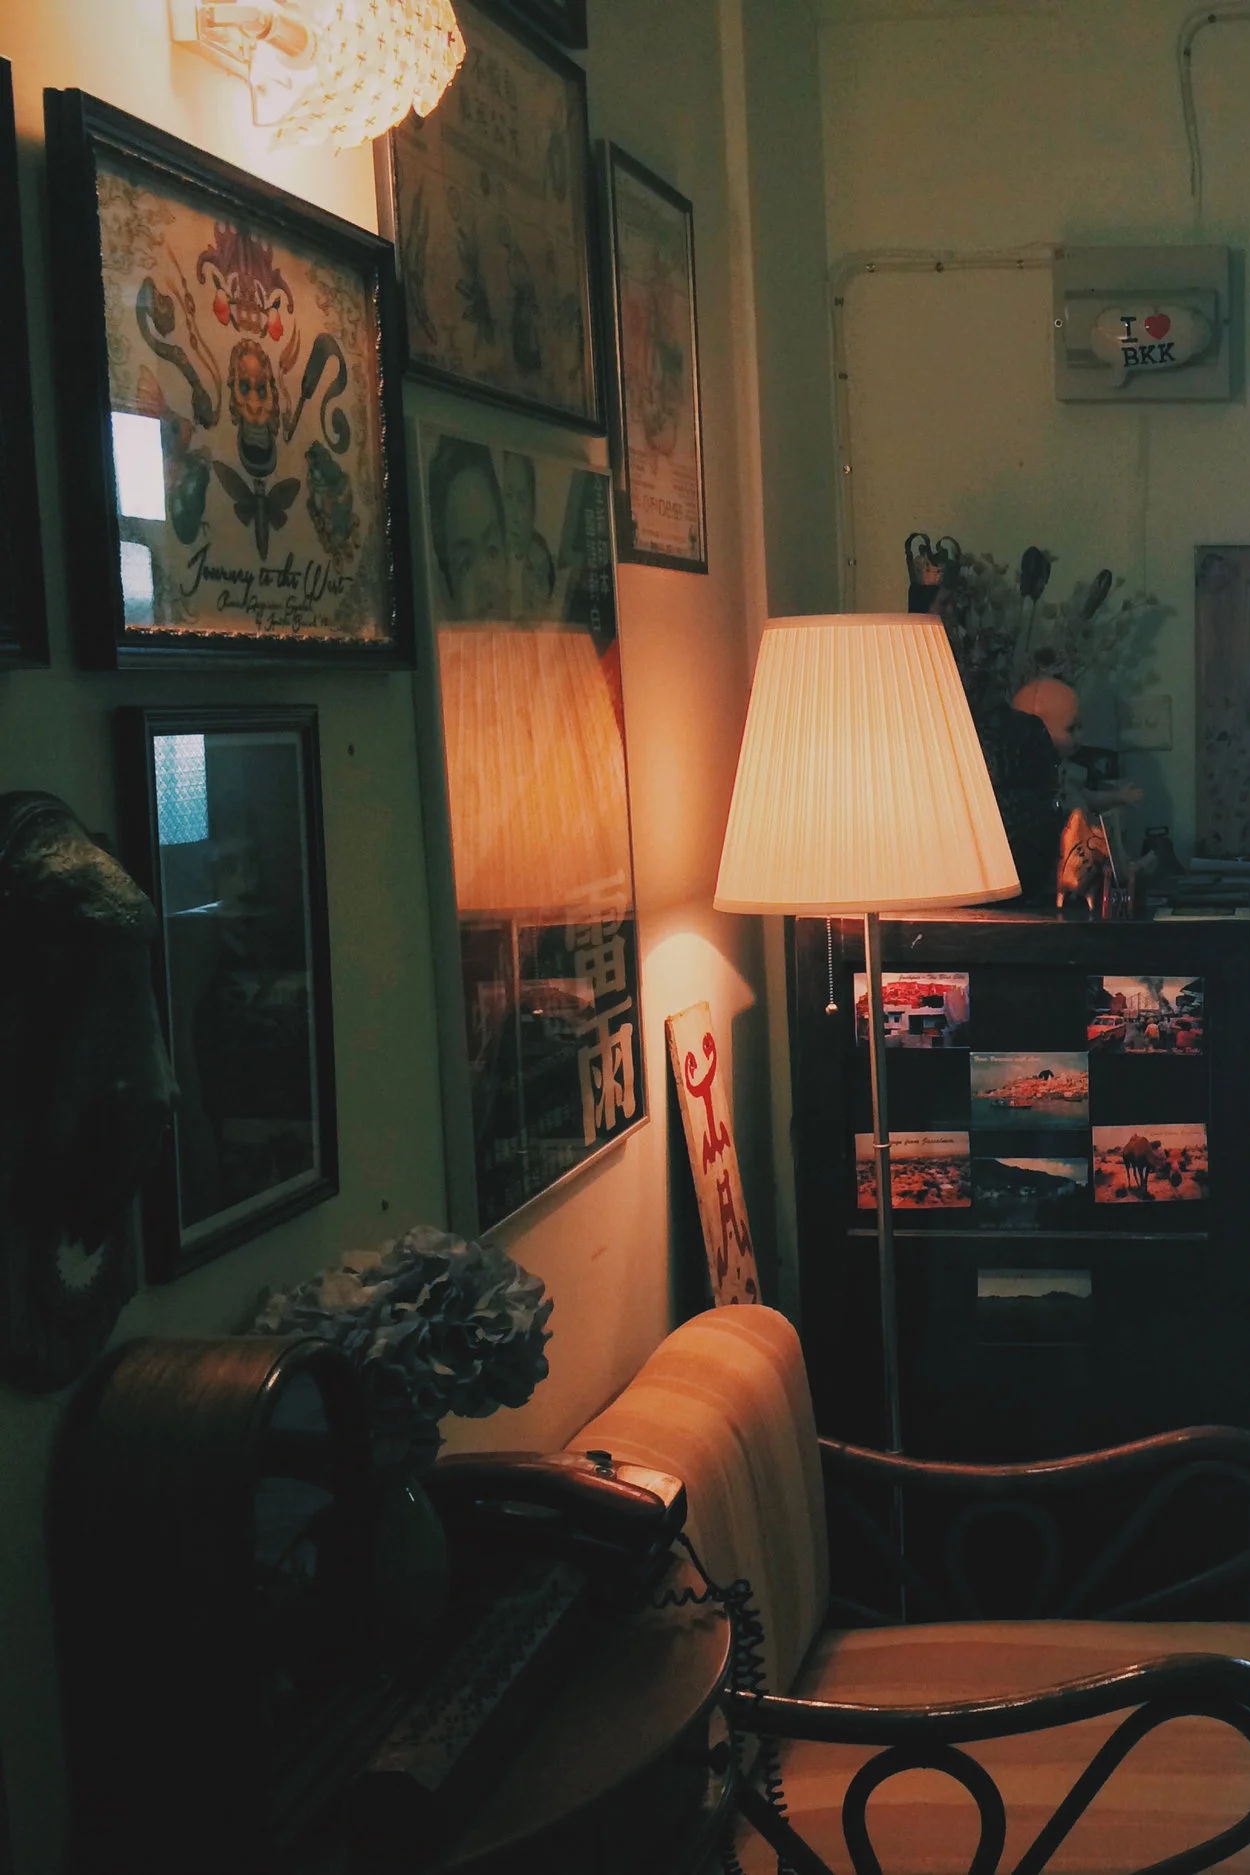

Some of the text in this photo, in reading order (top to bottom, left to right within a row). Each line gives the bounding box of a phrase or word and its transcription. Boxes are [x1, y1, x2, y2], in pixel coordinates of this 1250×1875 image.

[1120, 316, 1137, 344] I
[1121, 342, 1175, 367] BKK
[180, 542, 254, 605] Journey
[259, 567, 276, 587] to
[276, 552, 301, 590] the
[303, 559, 354, 601] West
